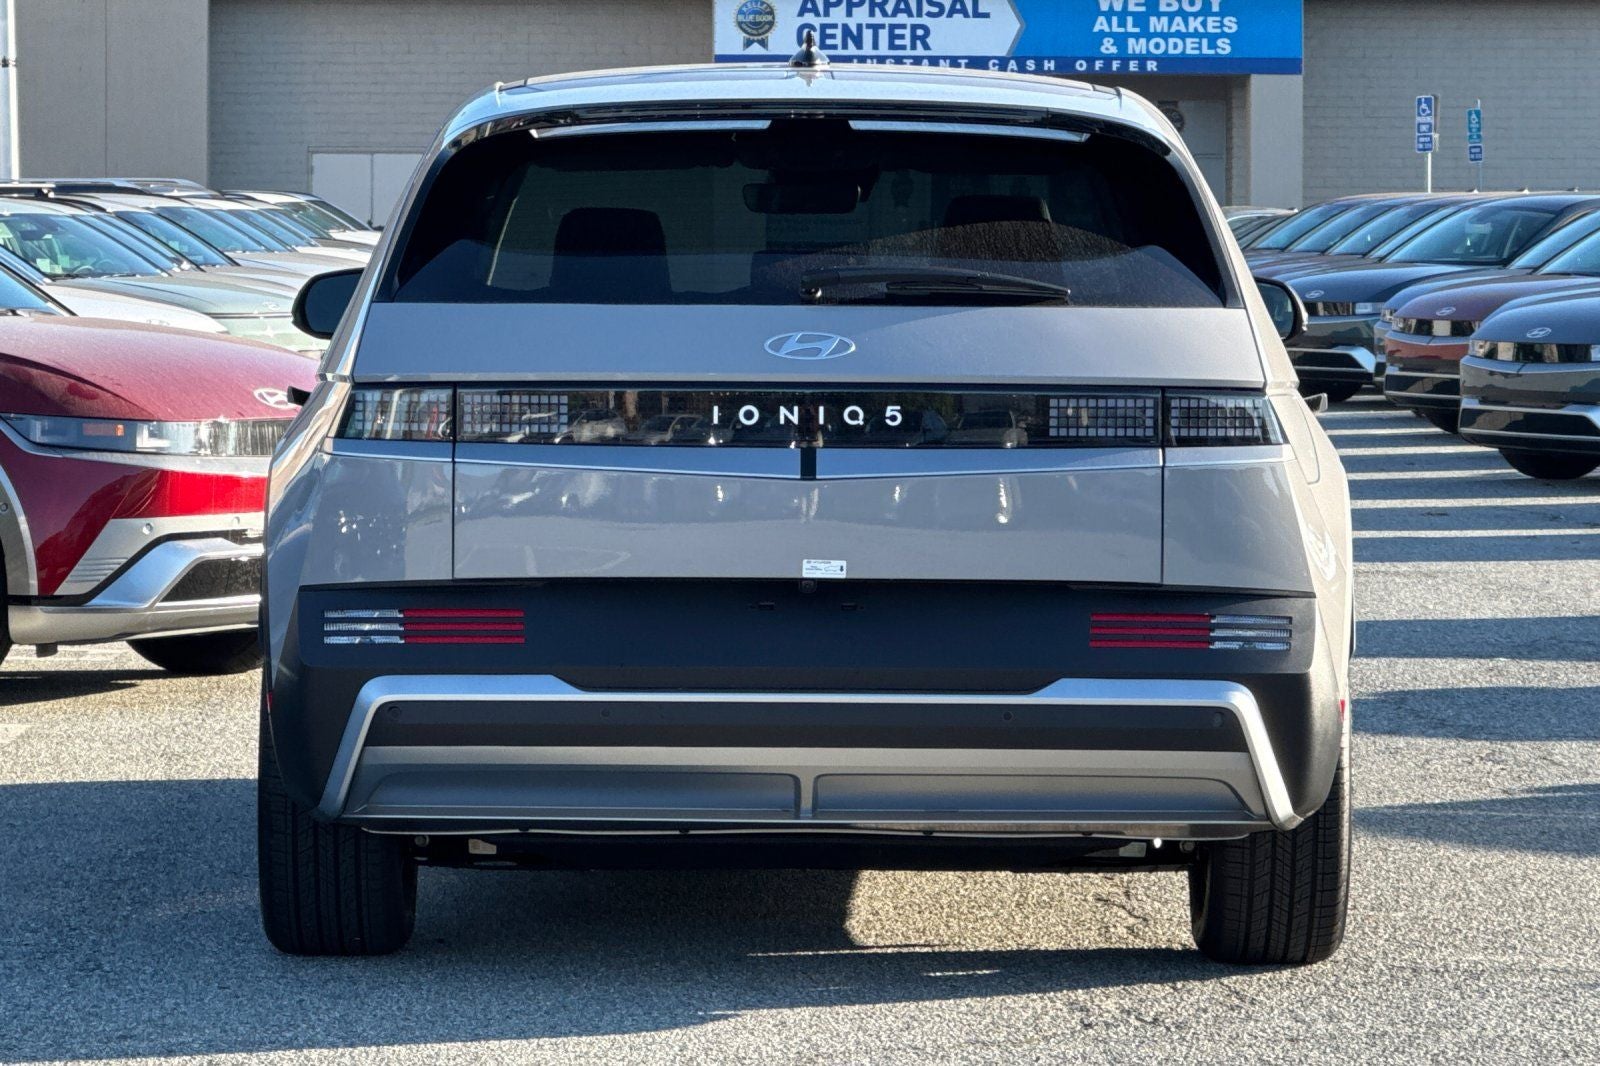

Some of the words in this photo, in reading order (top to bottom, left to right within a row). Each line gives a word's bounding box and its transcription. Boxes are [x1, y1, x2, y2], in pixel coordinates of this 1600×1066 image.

[796, 0, 991, 19] APPRAISAL
[1099, 0, 1147, 12] WE
[1158, 0, 1223, 12] BUY
[1092, 16, 1140, 33] ALL
[1149, 16, 1238, 33] MAKES
[796, 22, 932, 51] CENTER
[1100, 37, 1118, 55] &
[1127, 37, 1232, 55] MODELS
[988, 59, 1055, 72] CASH
[1075, 60, 1159, 72] OFFER
[713, 404, 865, 426] IONIQ
[884, 405, 903, 427] 5
